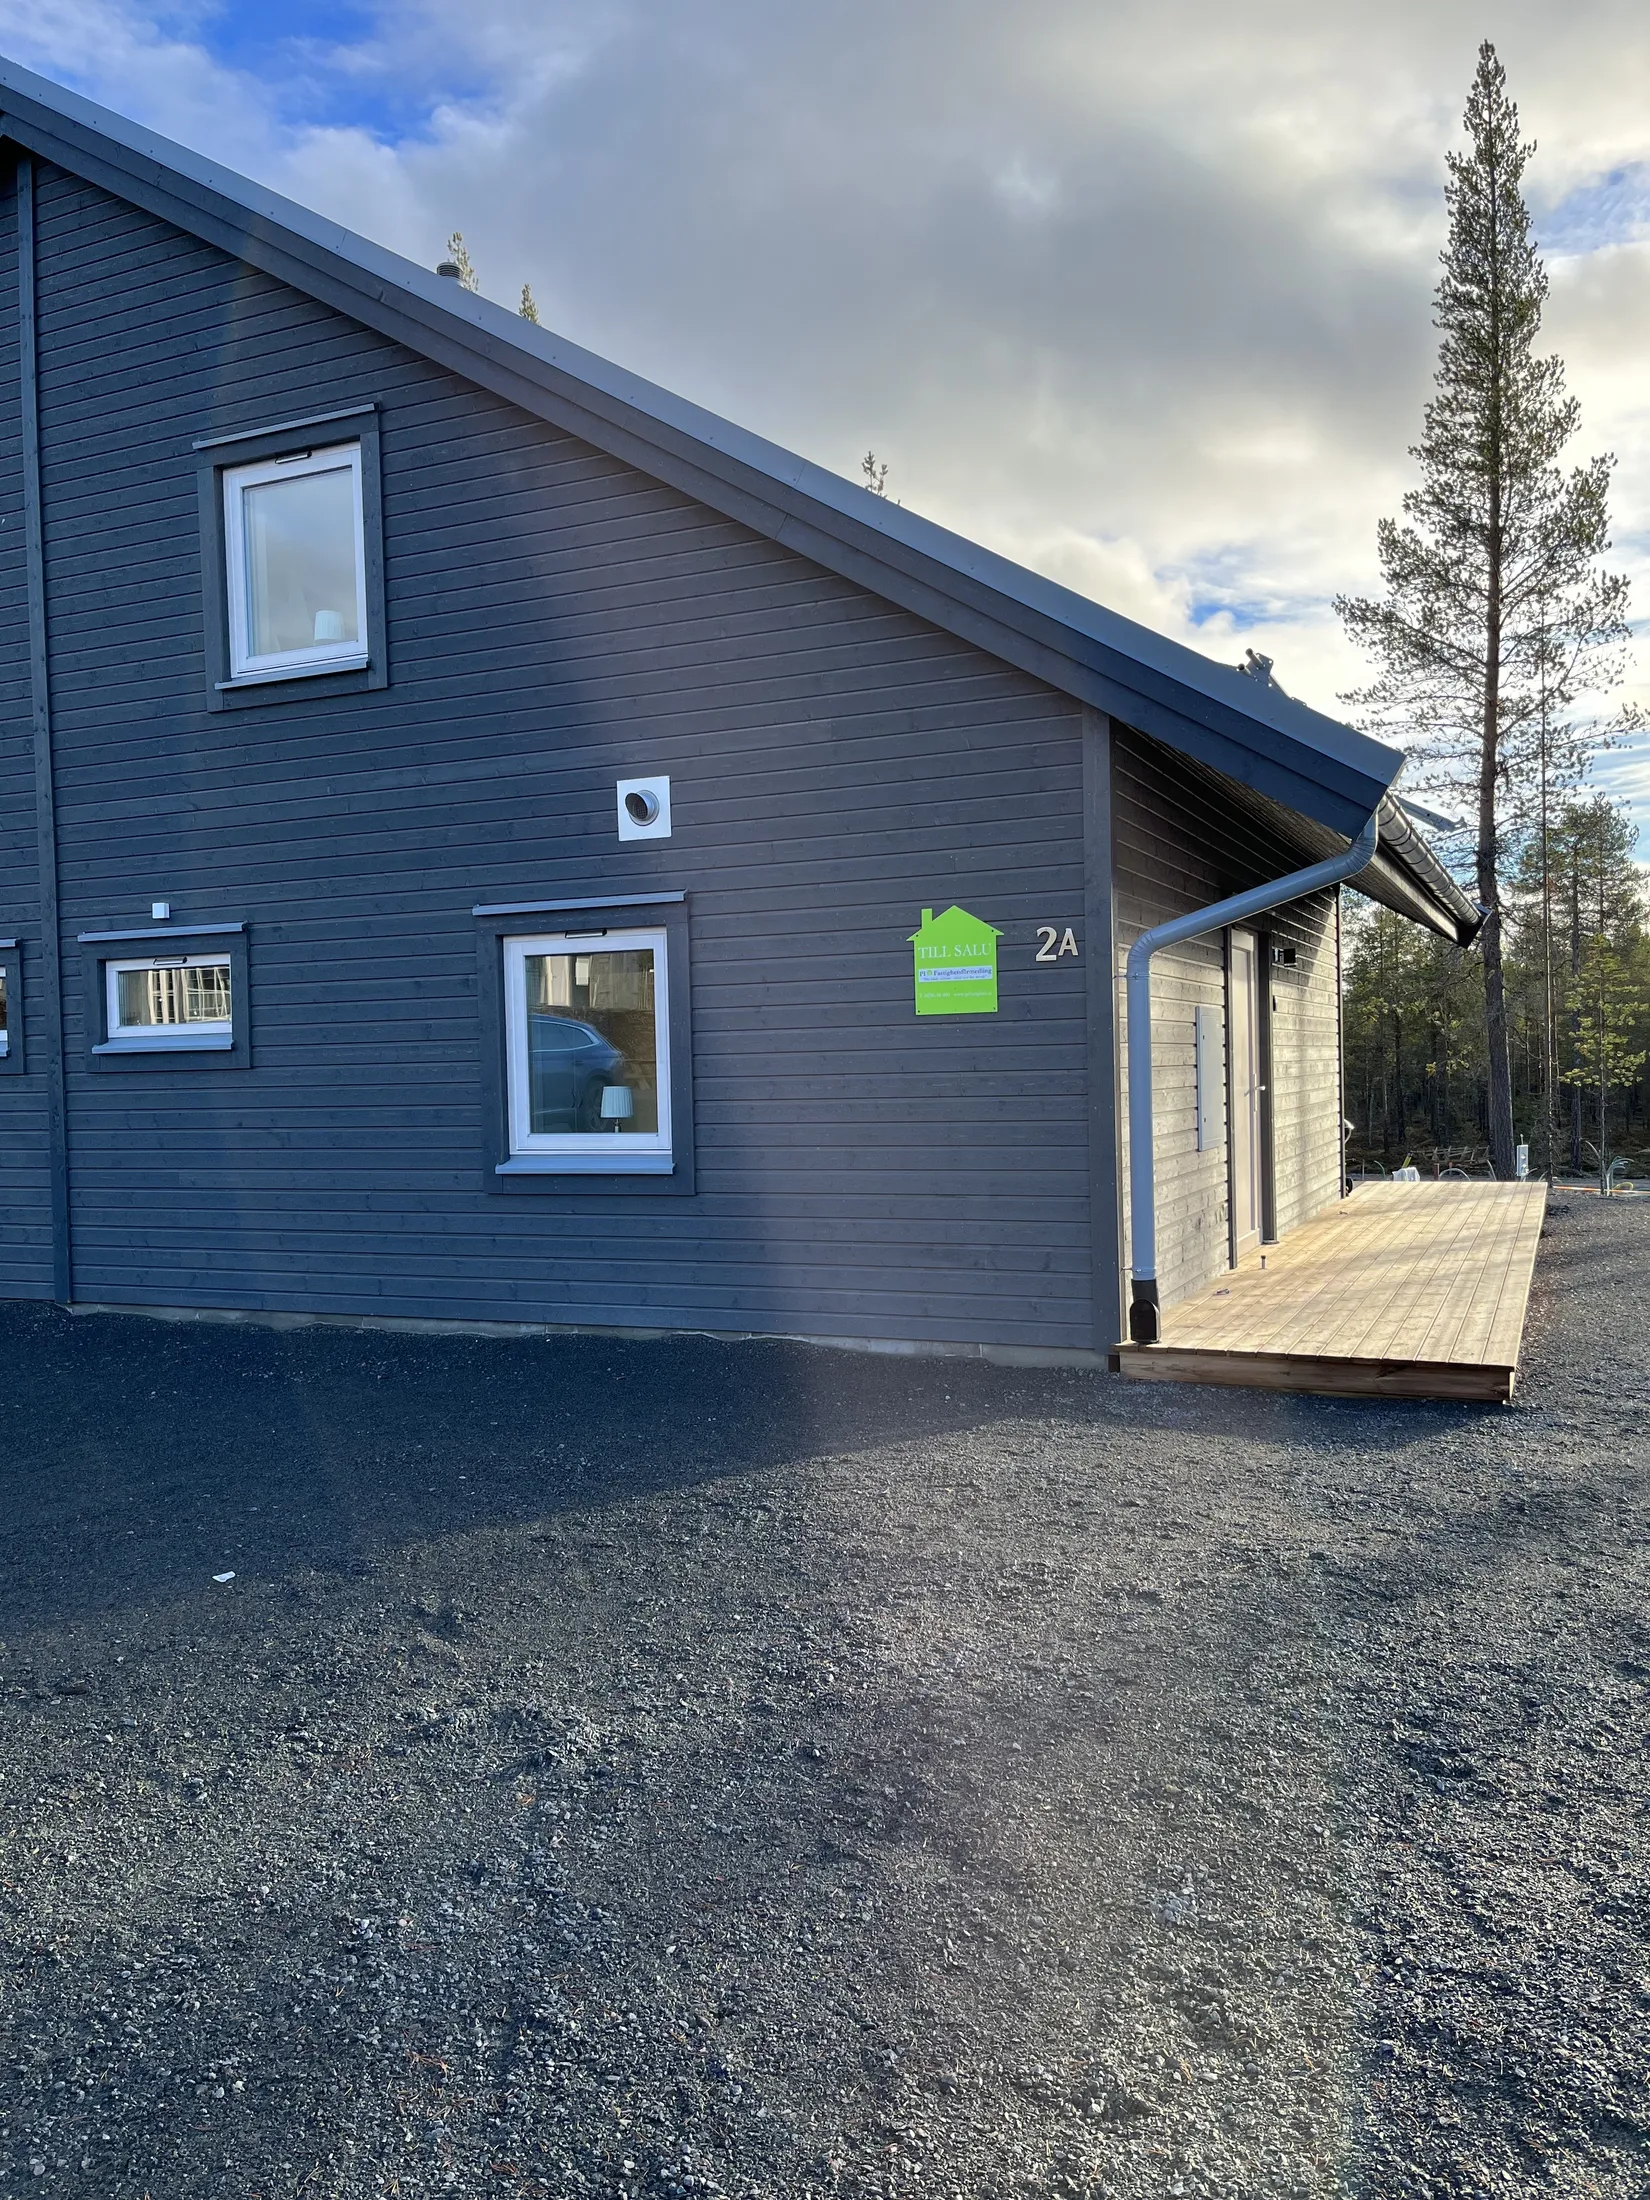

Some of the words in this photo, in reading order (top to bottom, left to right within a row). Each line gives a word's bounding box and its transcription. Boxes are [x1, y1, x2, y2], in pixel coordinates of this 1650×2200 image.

[918, 945, 951, 959] TILL
[954, 943, 992, 956] SALU
[1035, 926, 1079, 961] 2A
